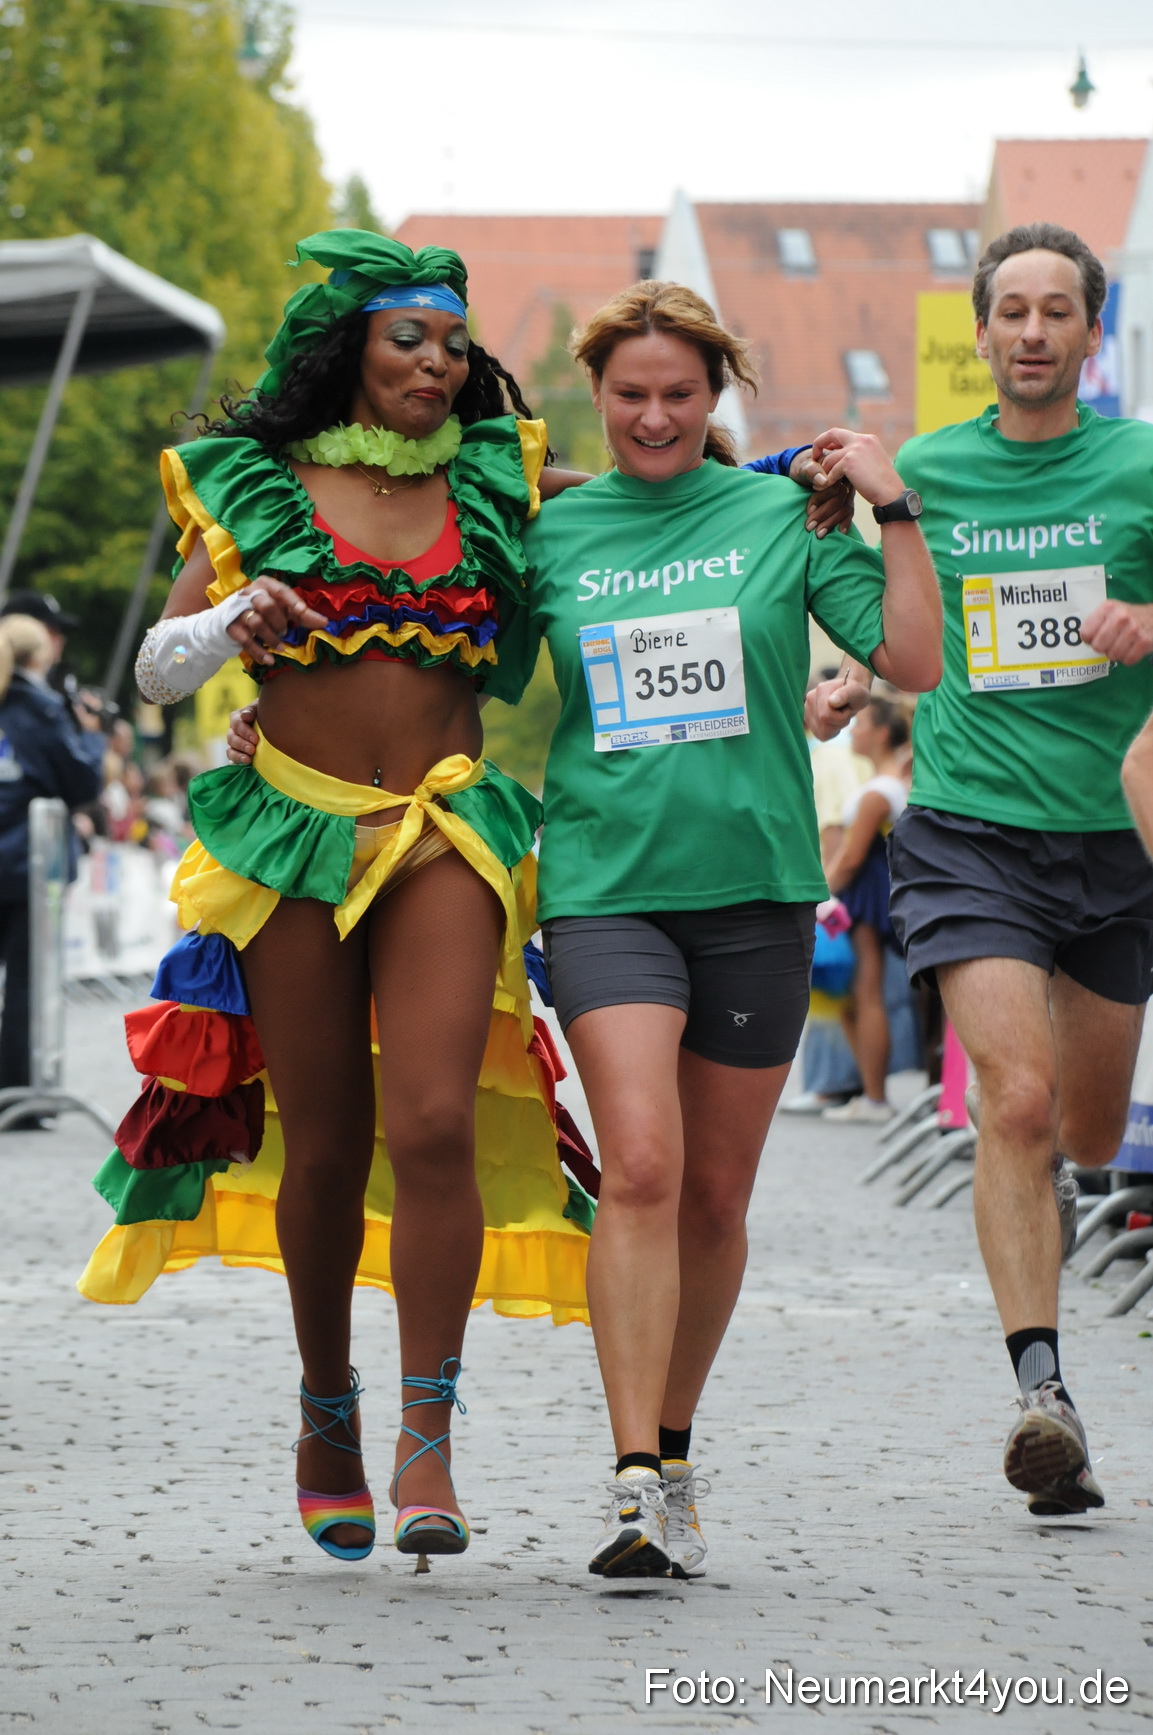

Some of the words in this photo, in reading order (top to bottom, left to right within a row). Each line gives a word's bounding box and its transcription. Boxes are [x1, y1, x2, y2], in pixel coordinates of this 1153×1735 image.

[951, 514, 1102, 559] Sinupret
[577, 549, 744, 601] Sinupret
[1000, 581, 1067, 606] Michael
[630, 628, 688, 653] Biene
[971, 621, 980, 638] A
[1017, 616, 1082, 650] 388
[634, 659, 726, 701] 3550
[687, 716, 745, 732] PFLEIDERER
